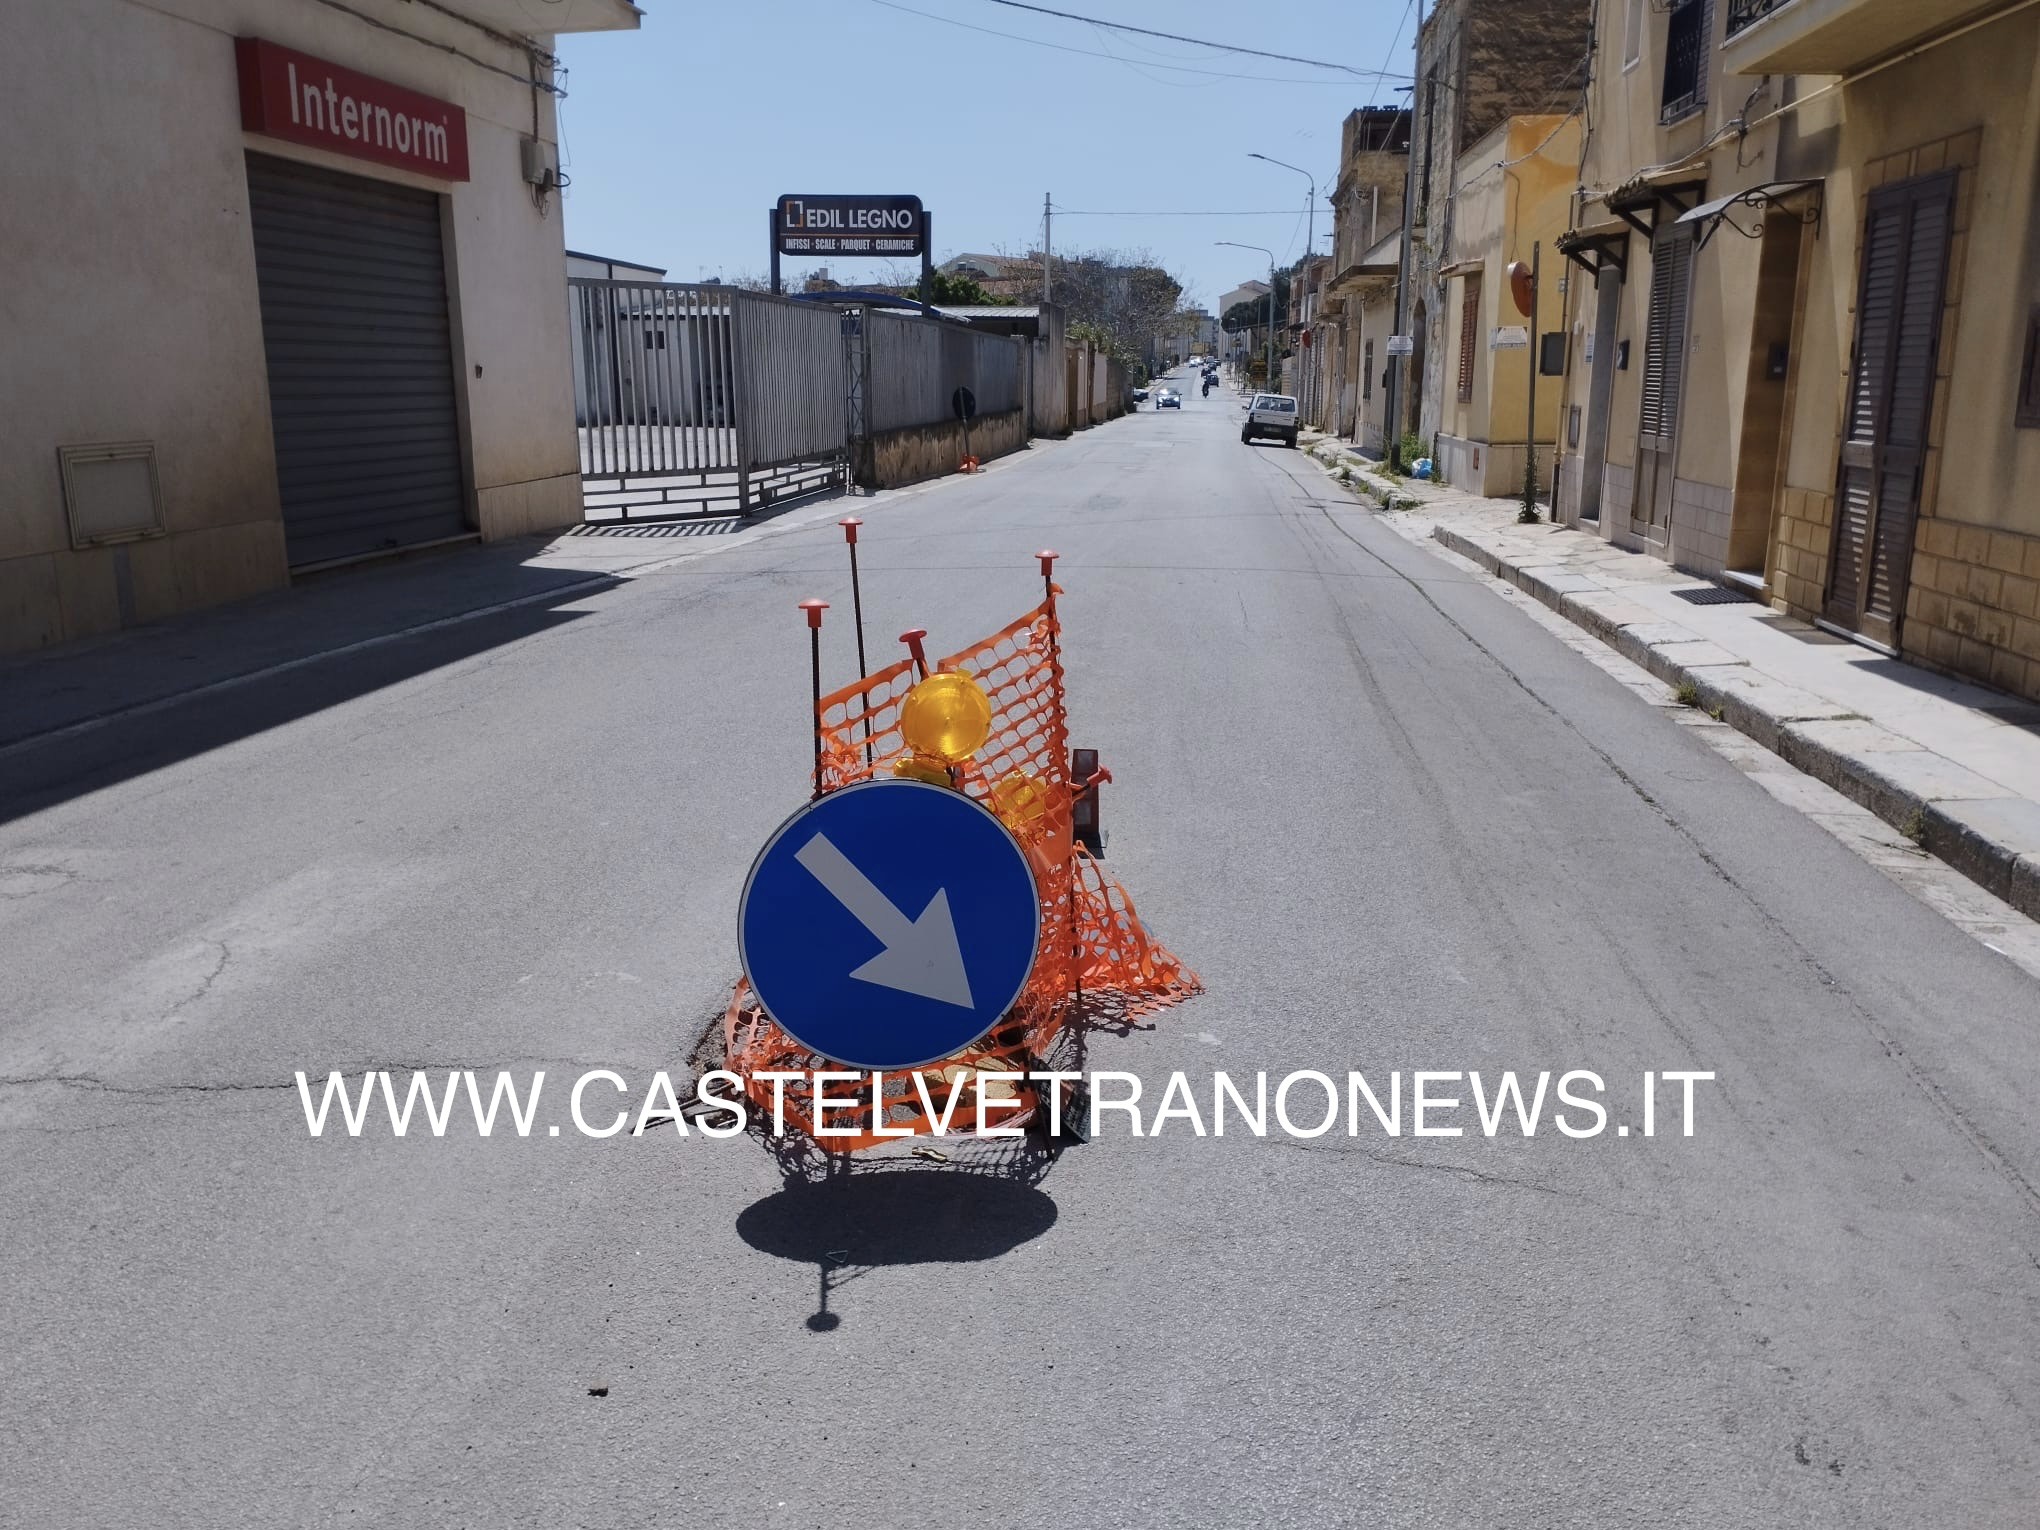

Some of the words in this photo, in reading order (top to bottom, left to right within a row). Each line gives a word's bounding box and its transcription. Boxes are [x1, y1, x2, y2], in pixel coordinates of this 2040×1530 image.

[287, 62, 449, 164] Internorm
[806, 208, 845, 228] EDIL
[849, 209, 913, 229] LEGNO
[785, 238, 810, 250] INFISSI
[815, 238, 836, 250] SCALE
[840, 238, 871, 251] PARQUET
[875, 239, 914, 251] CERAMICHE
